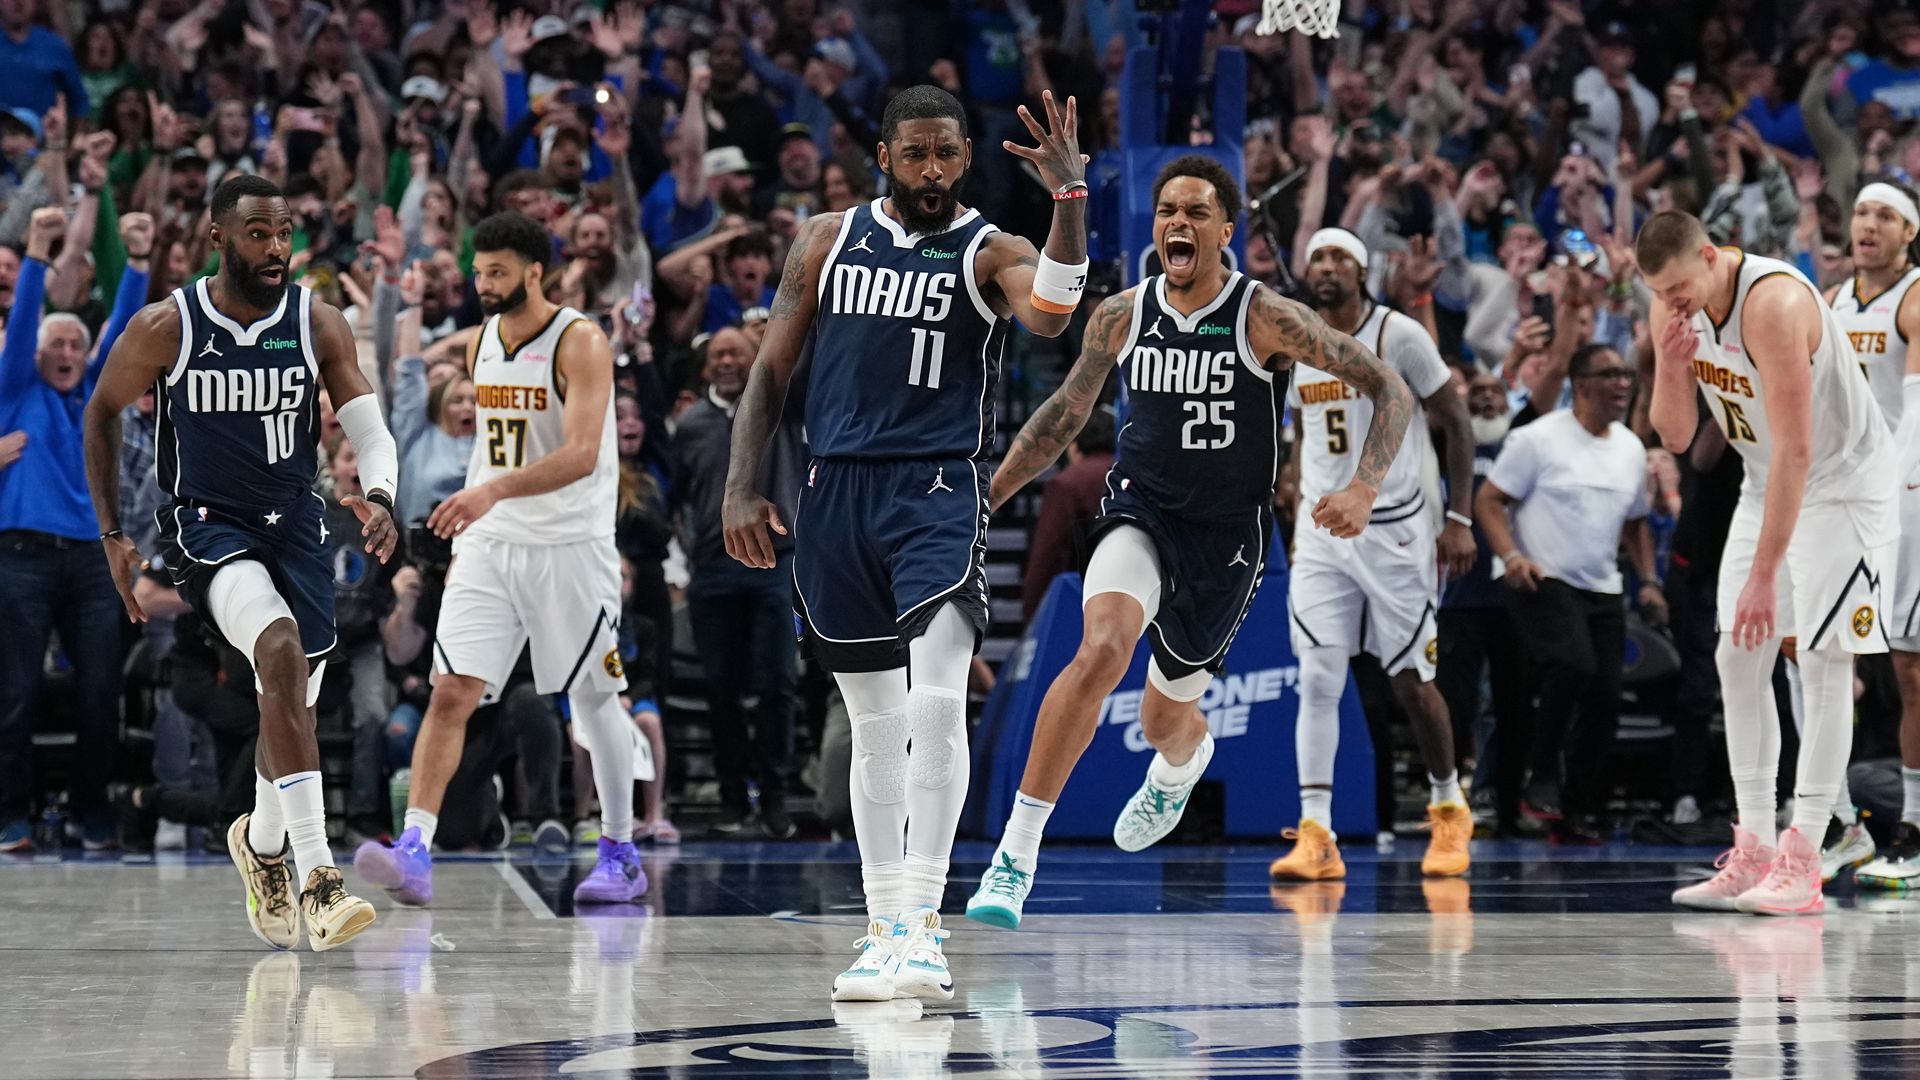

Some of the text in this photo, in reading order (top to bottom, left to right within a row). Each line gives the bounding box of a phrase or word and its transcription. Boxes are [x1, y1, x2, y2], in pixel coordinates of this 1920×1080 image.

[921, 247, 957, 260] chime
[832, 263, 957, 322] MAVS
[262, 338, 298, 350] chime
[1198, 323, 1231, 336] chime
[907, 327, 946, 389] 11
[1130, 345, 1236, 395] MAVS
[187, 366, 305, 413] MAVS
[260, 410, 299, 465] 10
[486, 418, 528, 468] 27
[1181, 400, 1236, 450] 25
[1325, 408, 1349, 454] 5
[1714, 393, 1757, 443] 15
